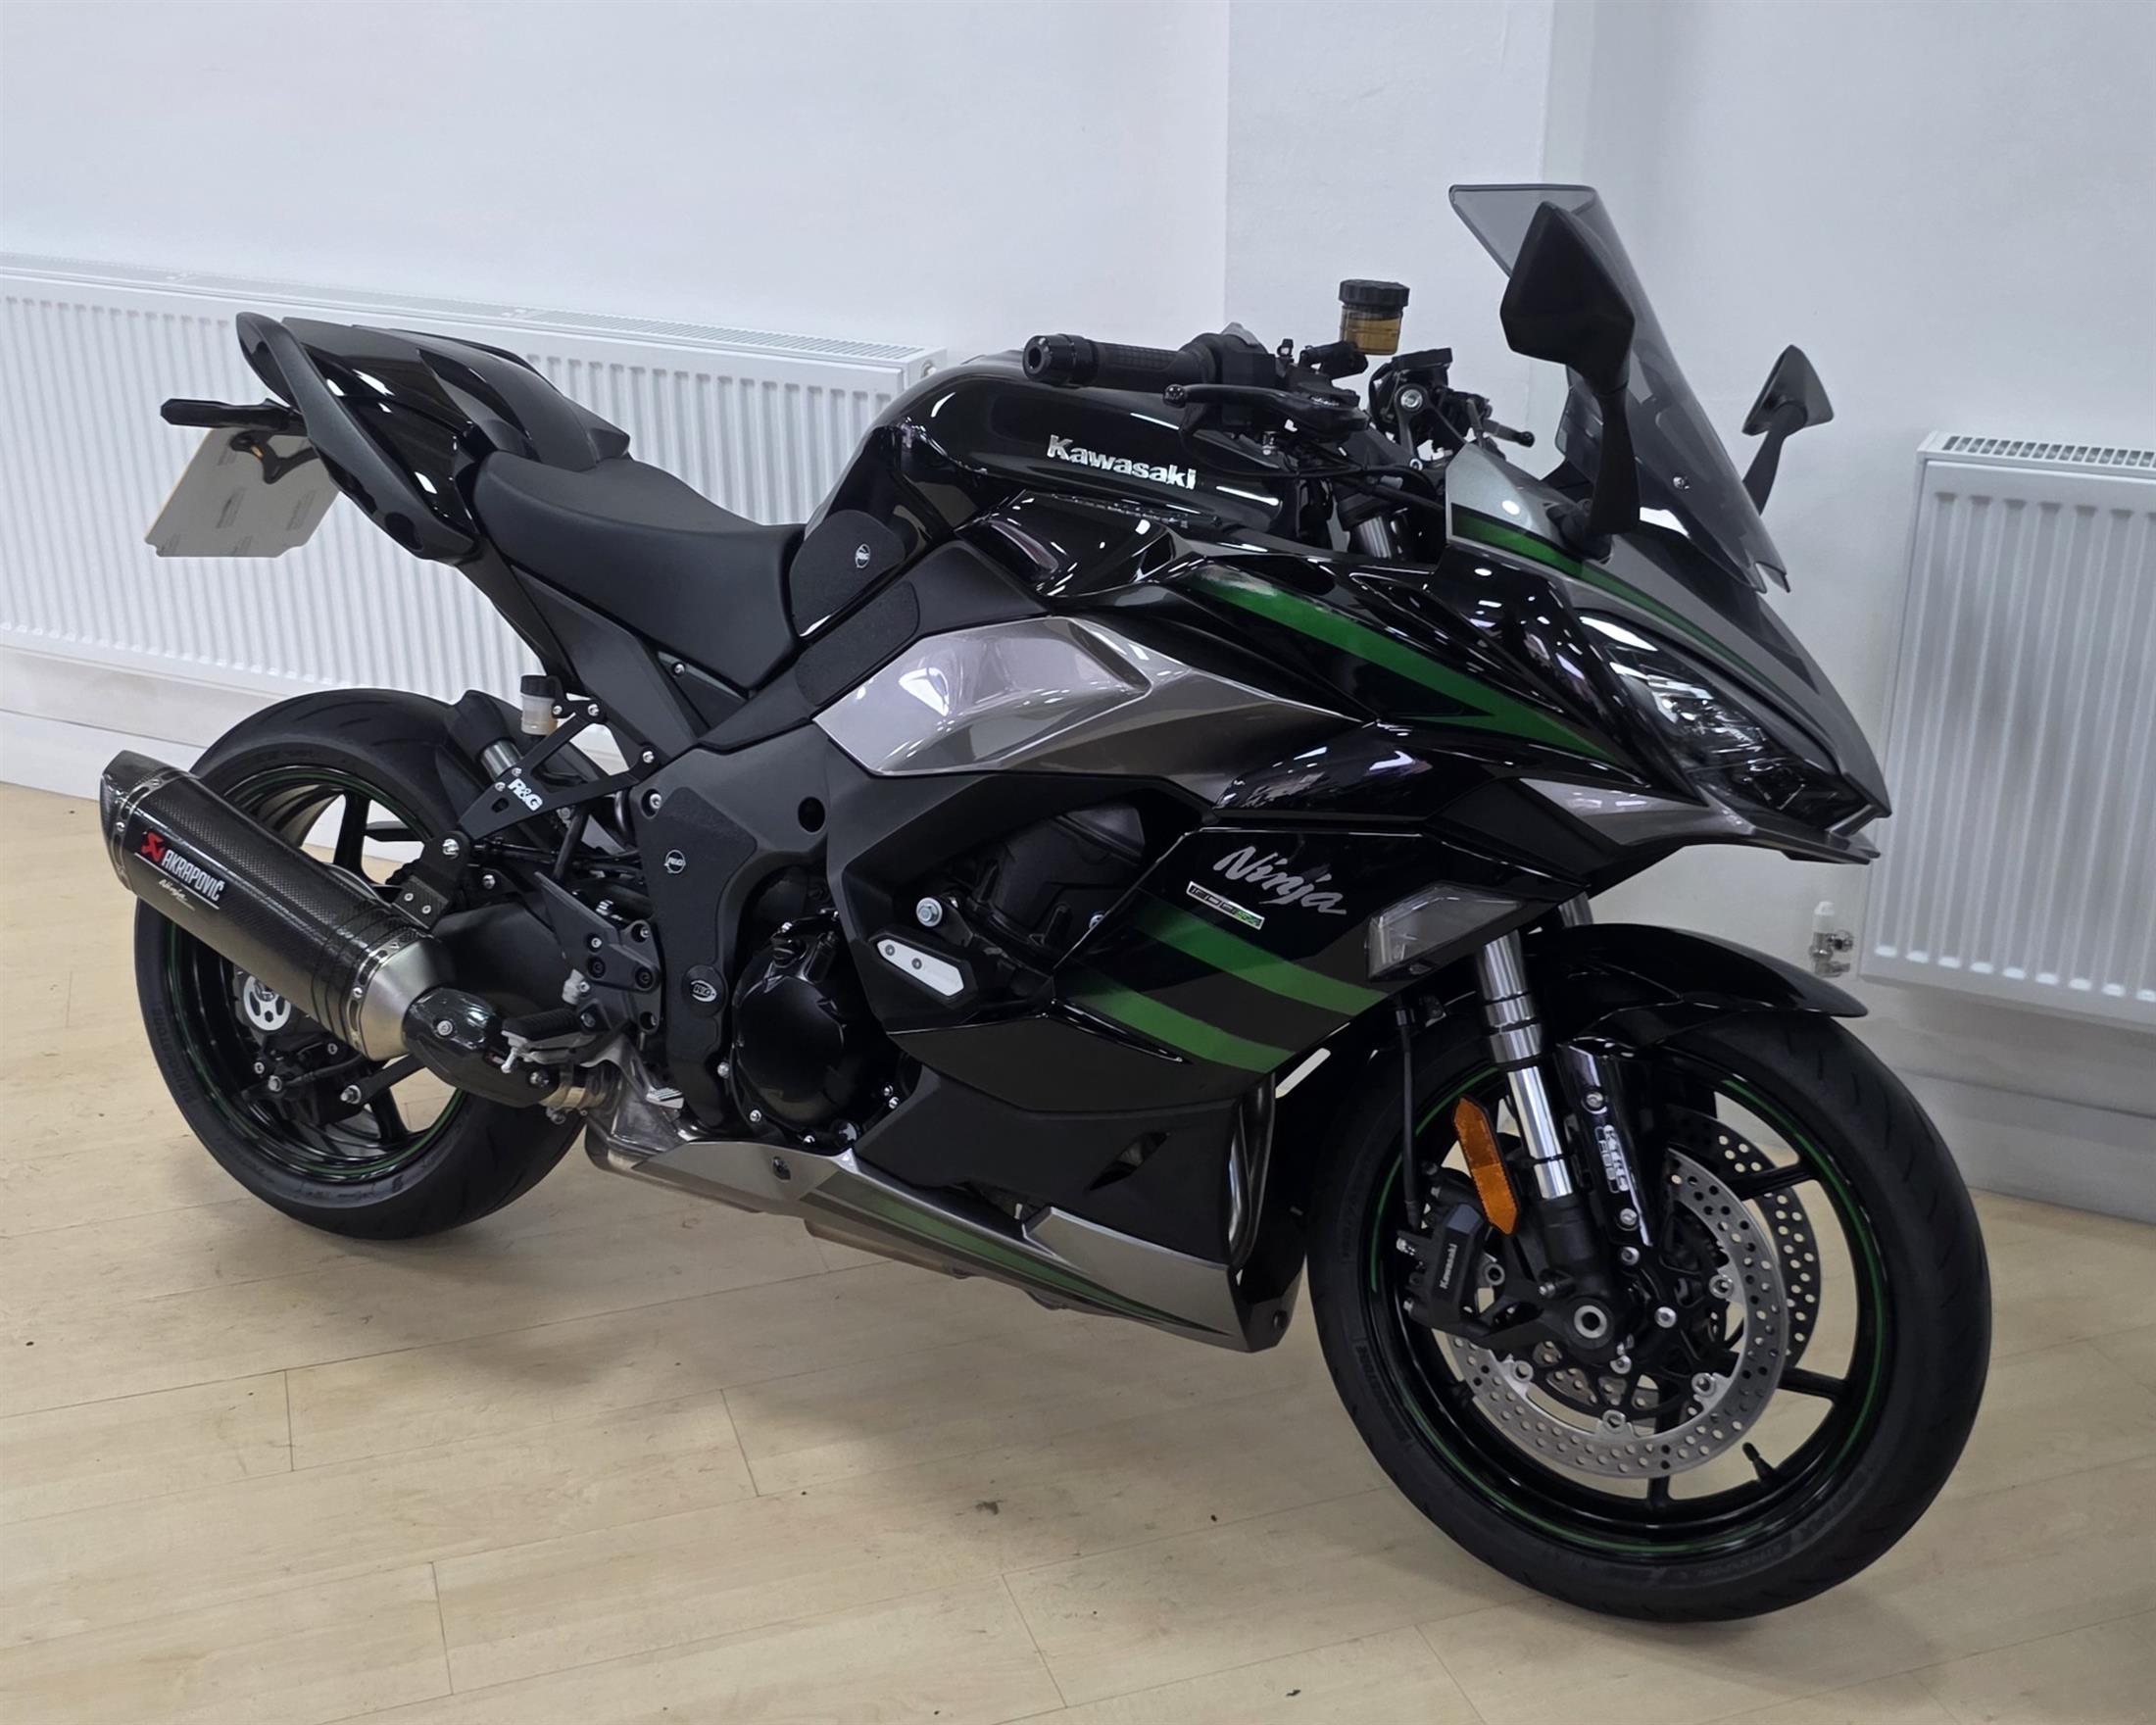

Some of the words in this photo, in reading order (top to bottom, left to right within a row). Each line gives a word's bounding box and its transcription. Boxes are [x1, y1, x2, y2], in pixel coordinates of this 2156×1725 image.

[1046, 433, 1197, 490] Kawasaki
[508, 778, 543, 812] R&G
[1212, 846, 1347, 914] Ninja
[1439, 1243, 1457, 1290] Kawasaki
